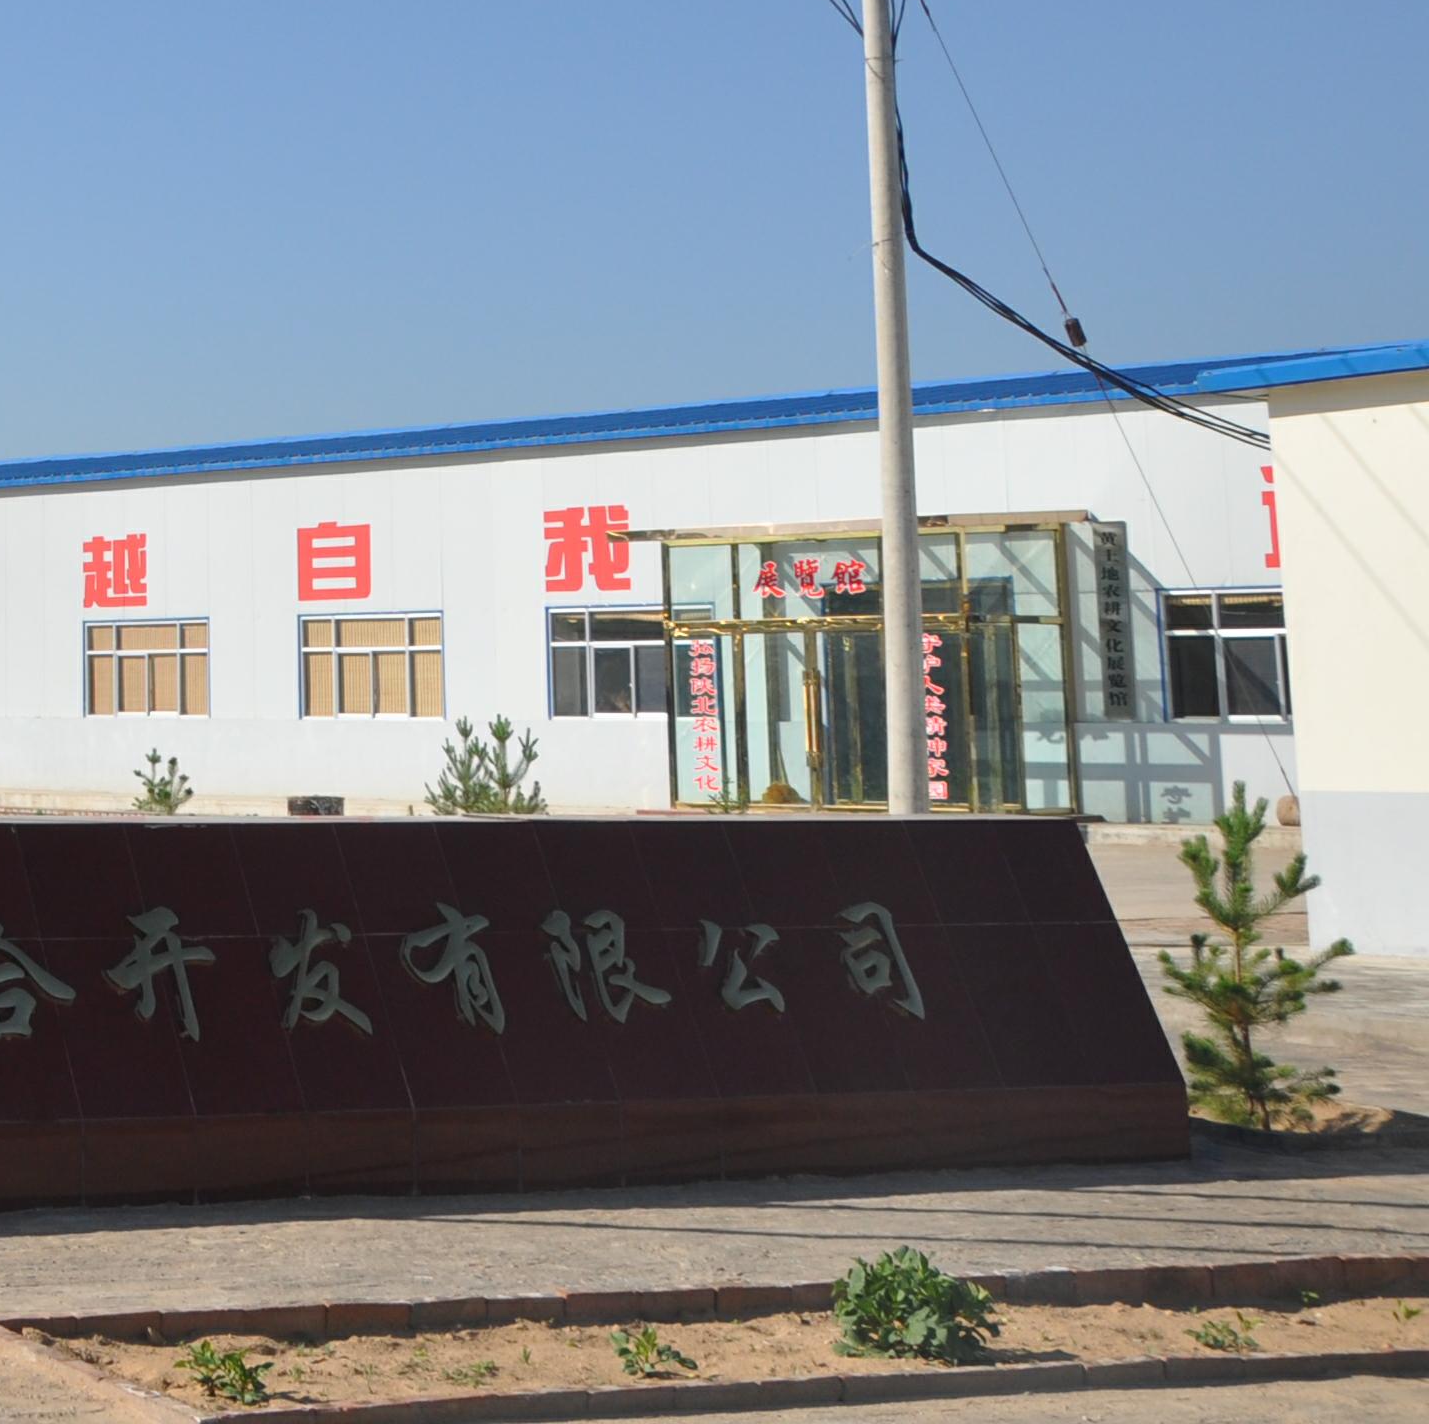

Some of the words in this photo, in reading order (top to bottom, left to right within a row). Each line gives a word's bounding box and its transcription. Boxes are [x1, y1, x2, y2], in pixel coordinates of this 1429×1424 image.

[1098, 531, 1129, 707] 黄土地农耕文化展览馆
[688, 639, 722, 793] 弘扬陕北农耕文化
